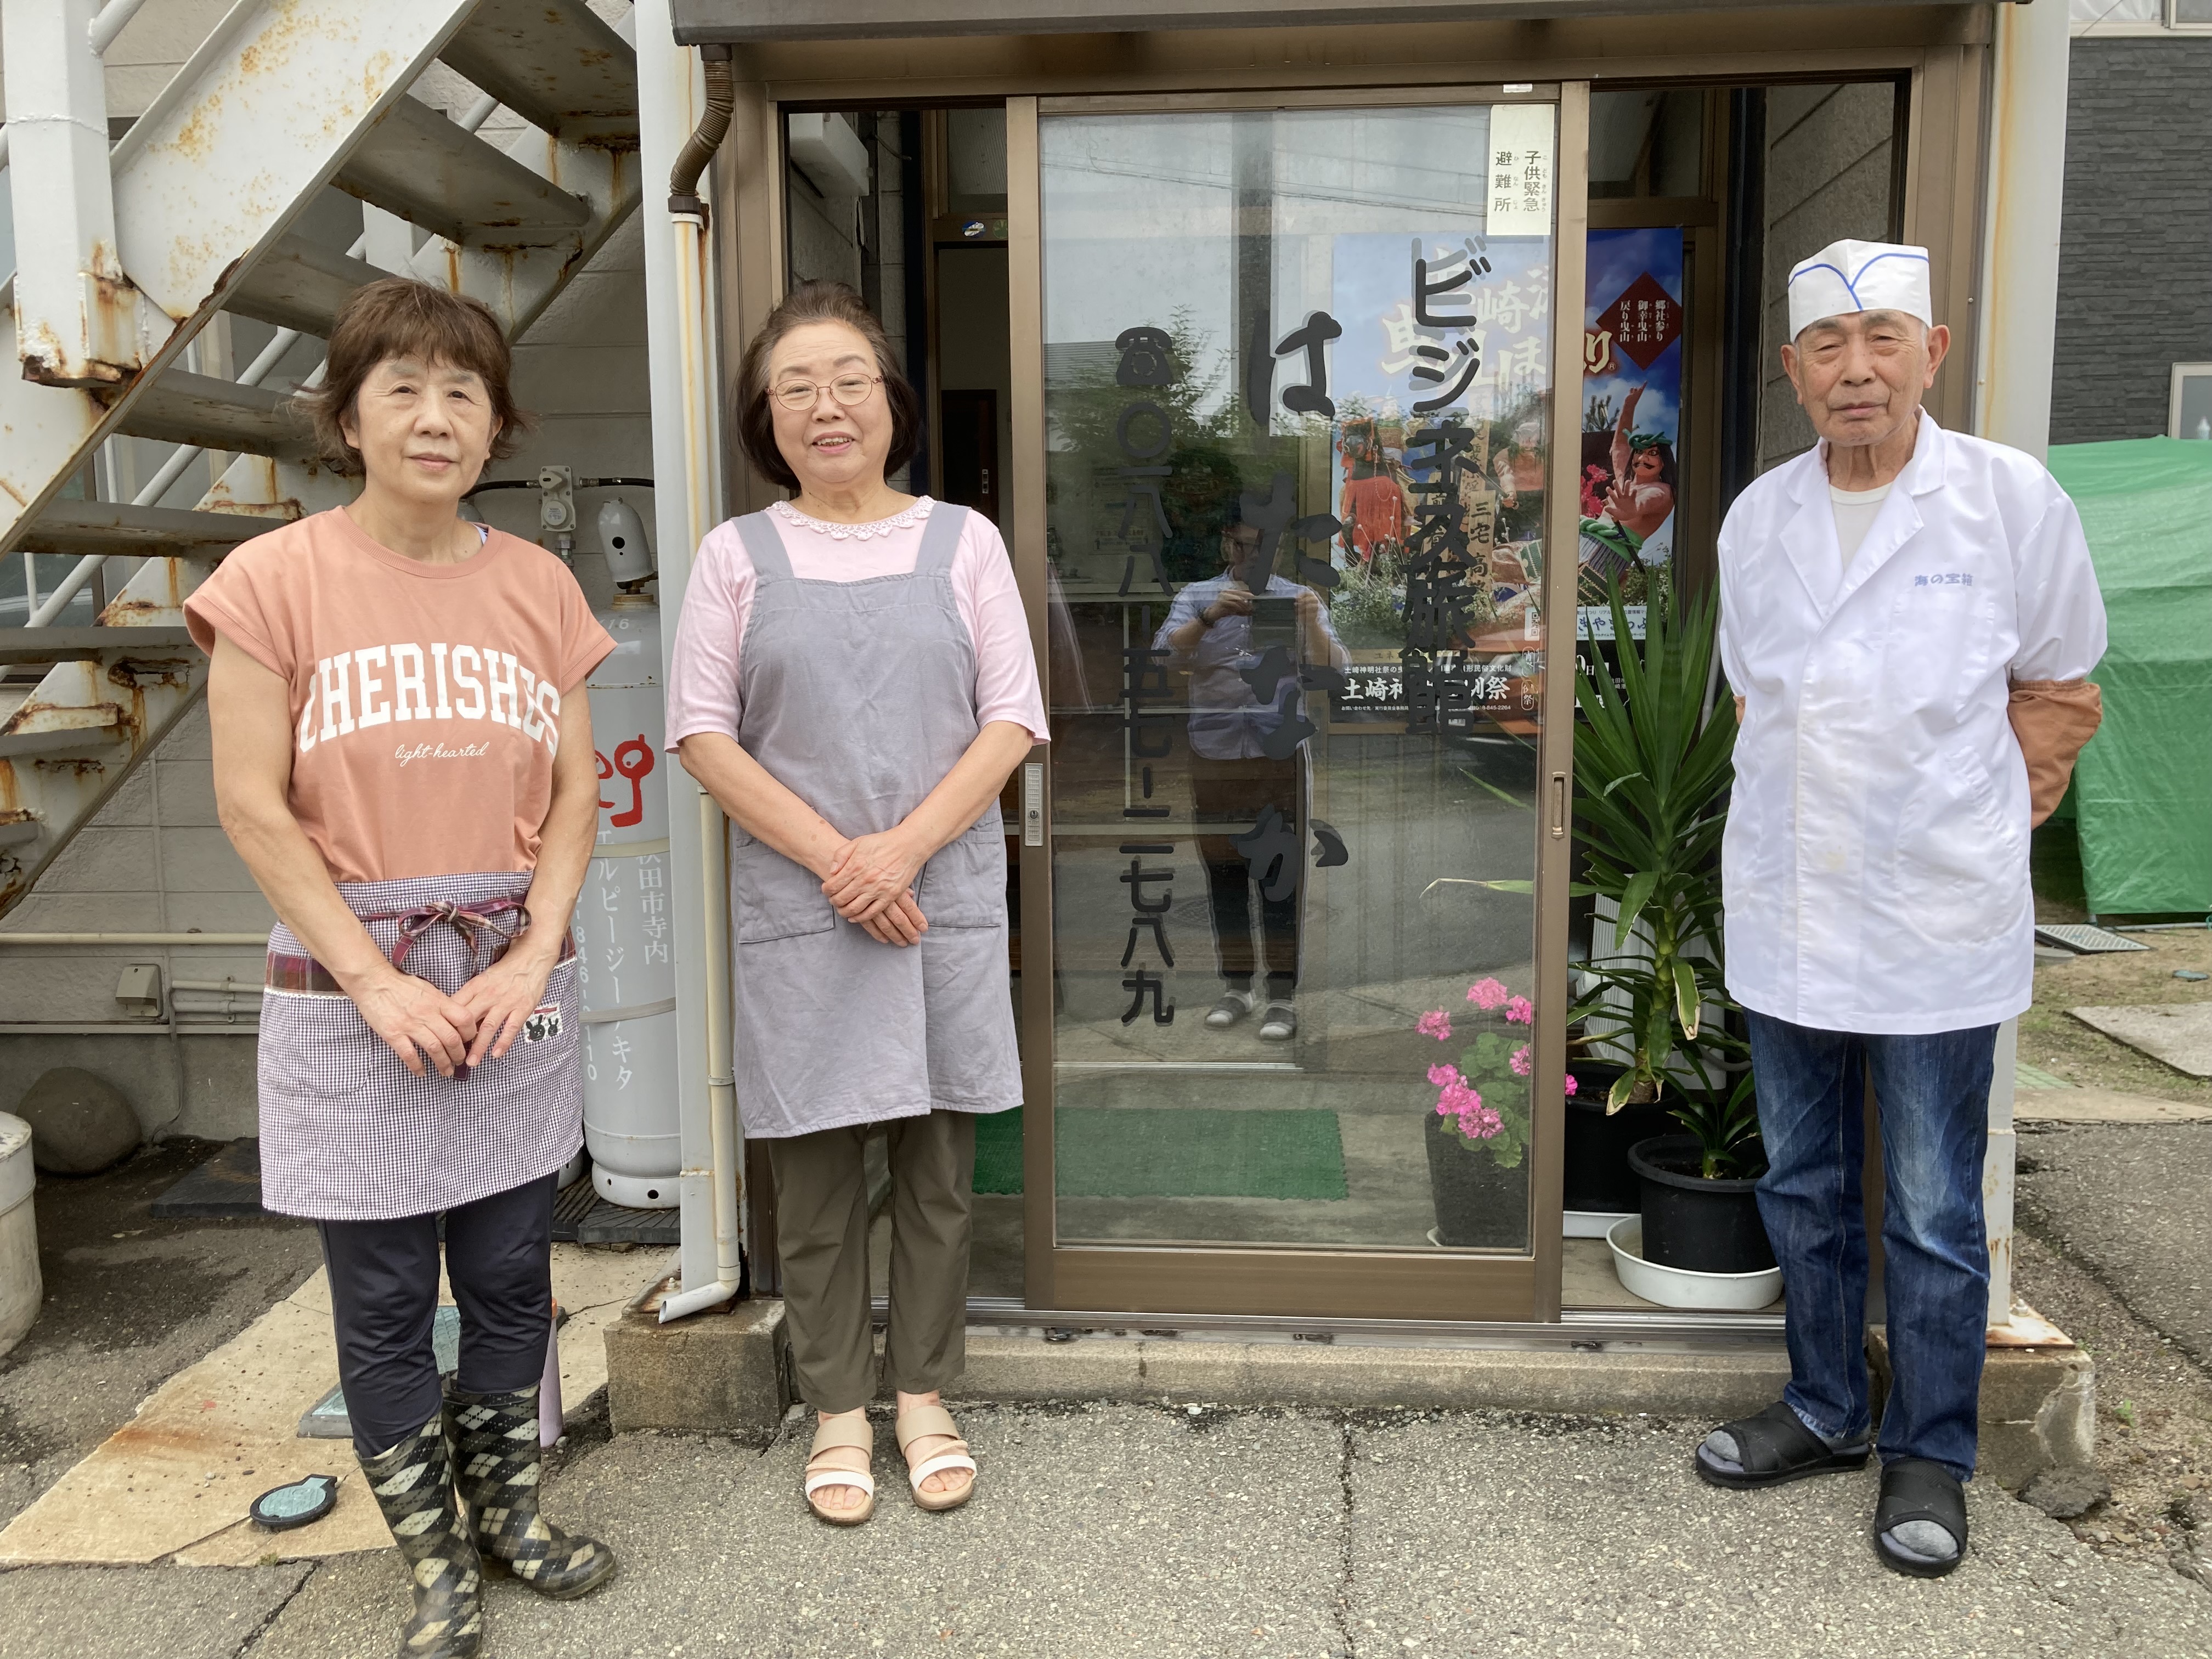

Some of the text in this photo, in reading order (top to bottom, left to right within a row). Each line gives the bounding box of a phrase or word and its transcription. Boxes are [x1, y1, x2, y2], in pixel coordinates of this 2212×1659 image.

[1493, 151, 1513, 212] 避難所
[1523, 150, 1542, 212] 子供緊急
[1400, 256, 1492, 734] ビジネス旅館
[1237, 311, 1349, 902] はたなか
[1463, 664, 1511, 673] 形民俗文化財
[395, 741, 490, 766] light-hearted
[596, 830, 633, 1091] エルピージーキタ
